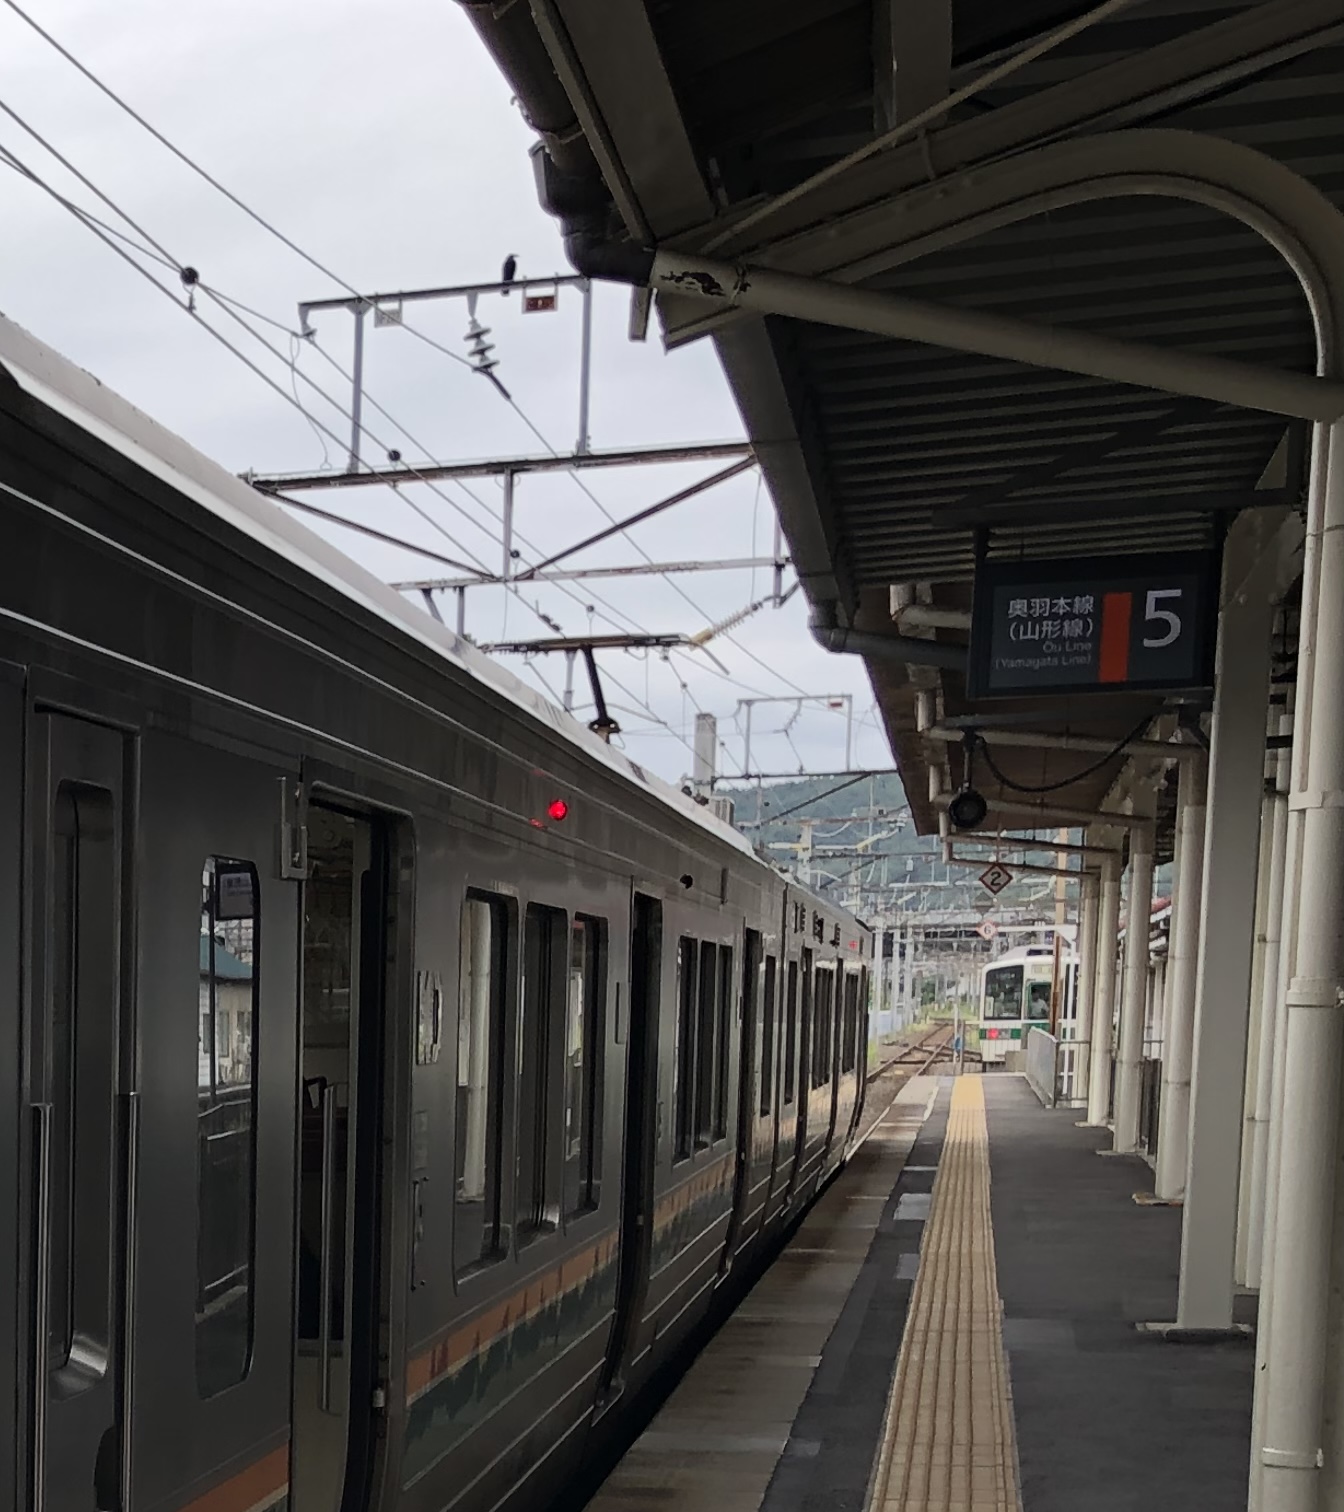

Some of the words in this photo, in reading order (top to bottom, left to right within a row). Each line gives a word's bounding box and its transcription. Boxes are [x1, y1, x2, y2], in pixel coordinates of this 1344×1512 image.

[1008, 595, 1094, 618] 奥羽本線
[1143, 589, 1182, 648] 5
[990, 872, 1001, 887] 2
